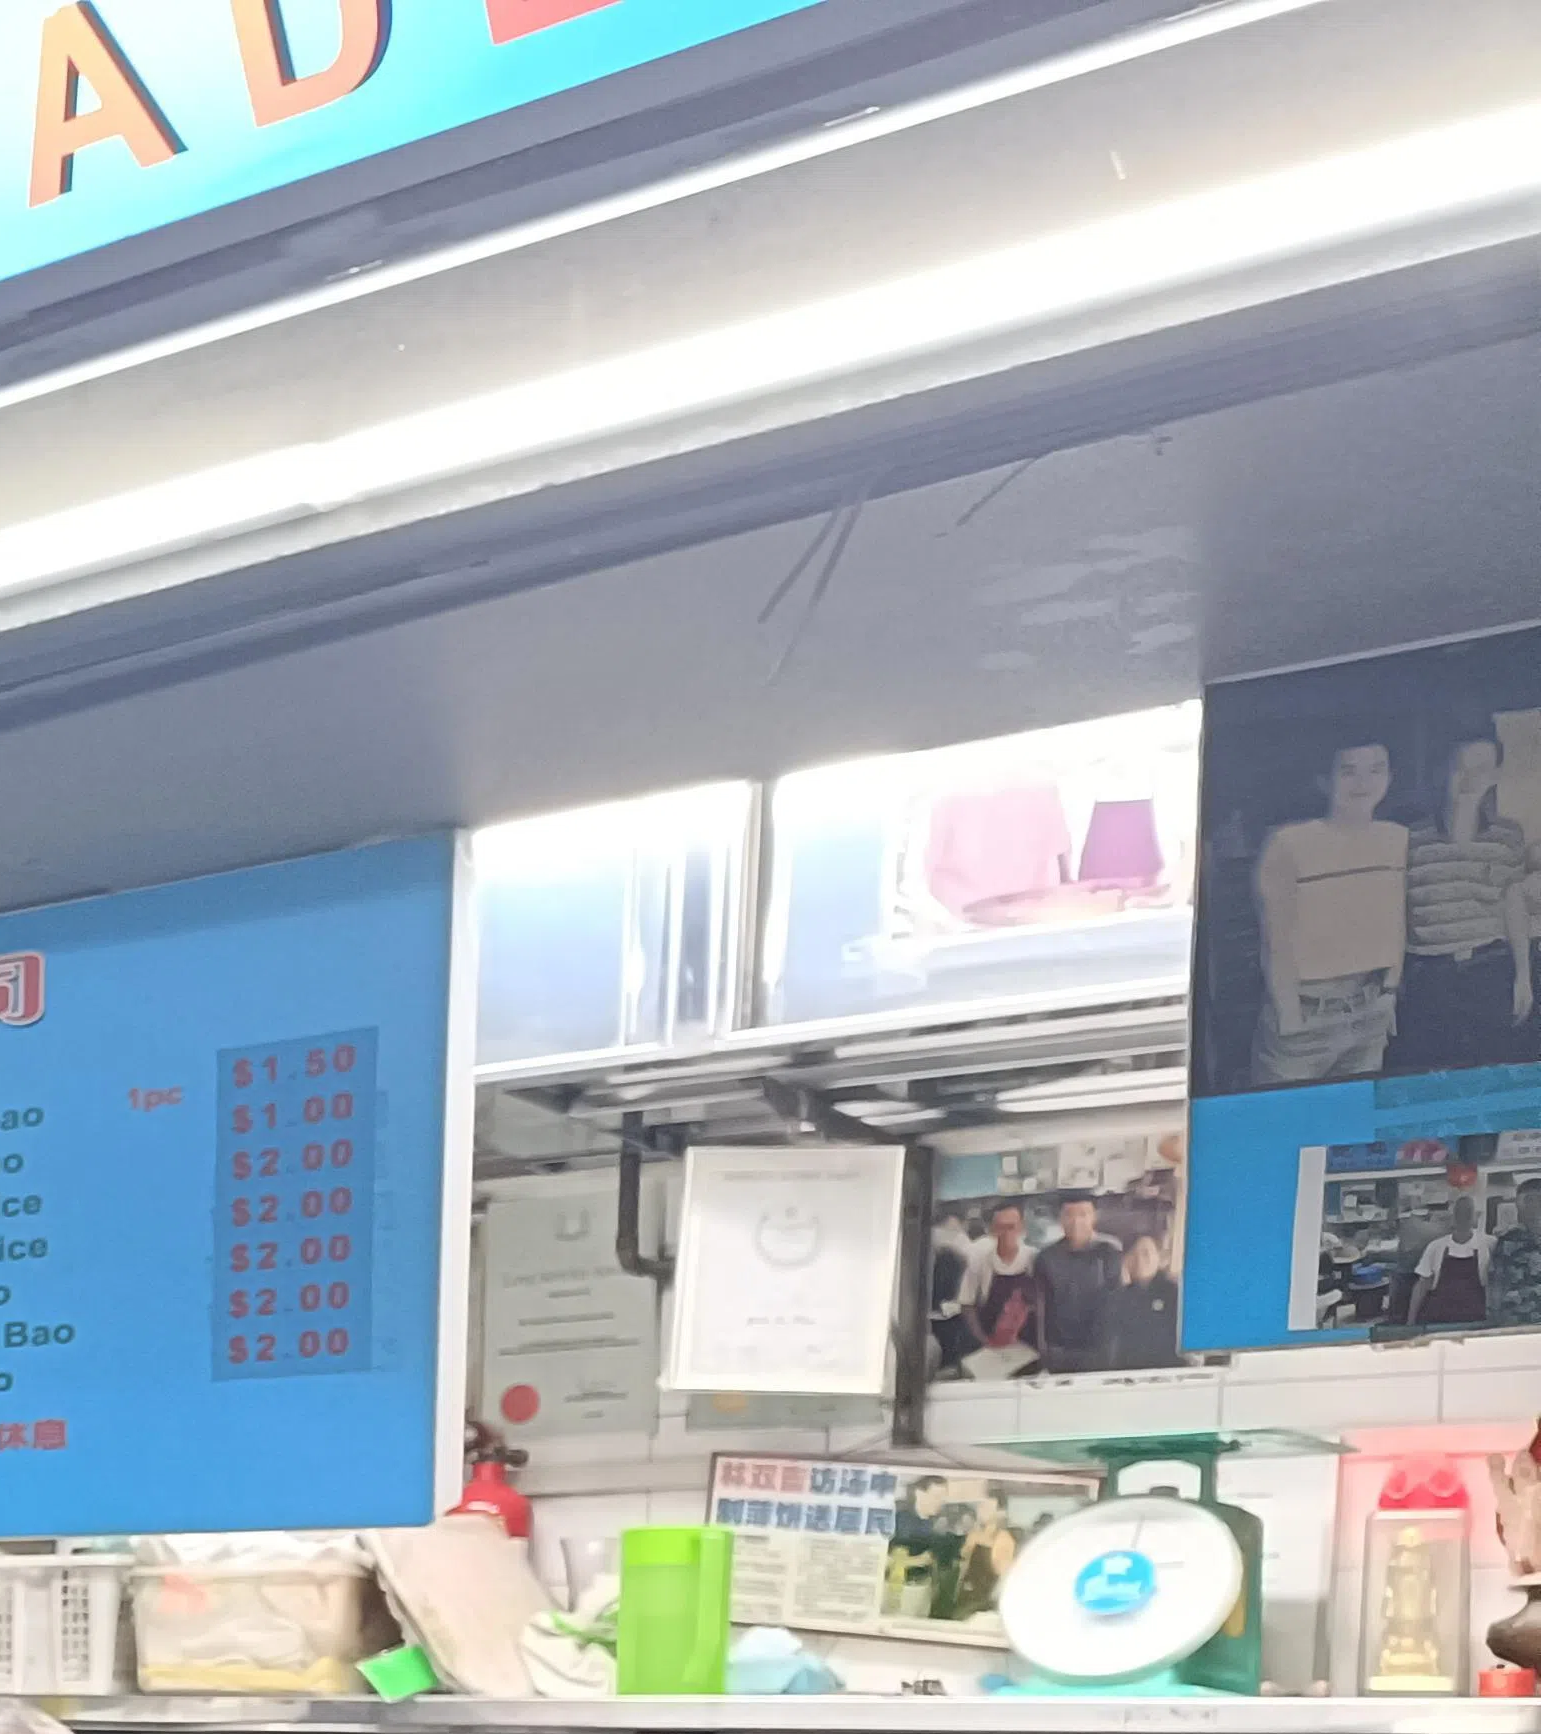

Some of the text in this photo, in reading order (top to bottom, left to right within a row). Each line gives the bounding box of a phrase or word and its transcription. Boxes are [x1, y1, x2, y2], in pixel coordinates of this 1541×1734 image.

[128, 1086, 183, 1113] 1pc
[231, 1091, 354, 1134] $1.00
[231, 1138, 353, 1180] $2.00
[231, 1186, 352, 1227] $2.00
[230, 1233, 352, 1272] $2.00
[228, 1281, 350, 1319] $2.00
[4, 1321, 75, 1349] Bao
[228, 1327, 349, 1364] $2.00
